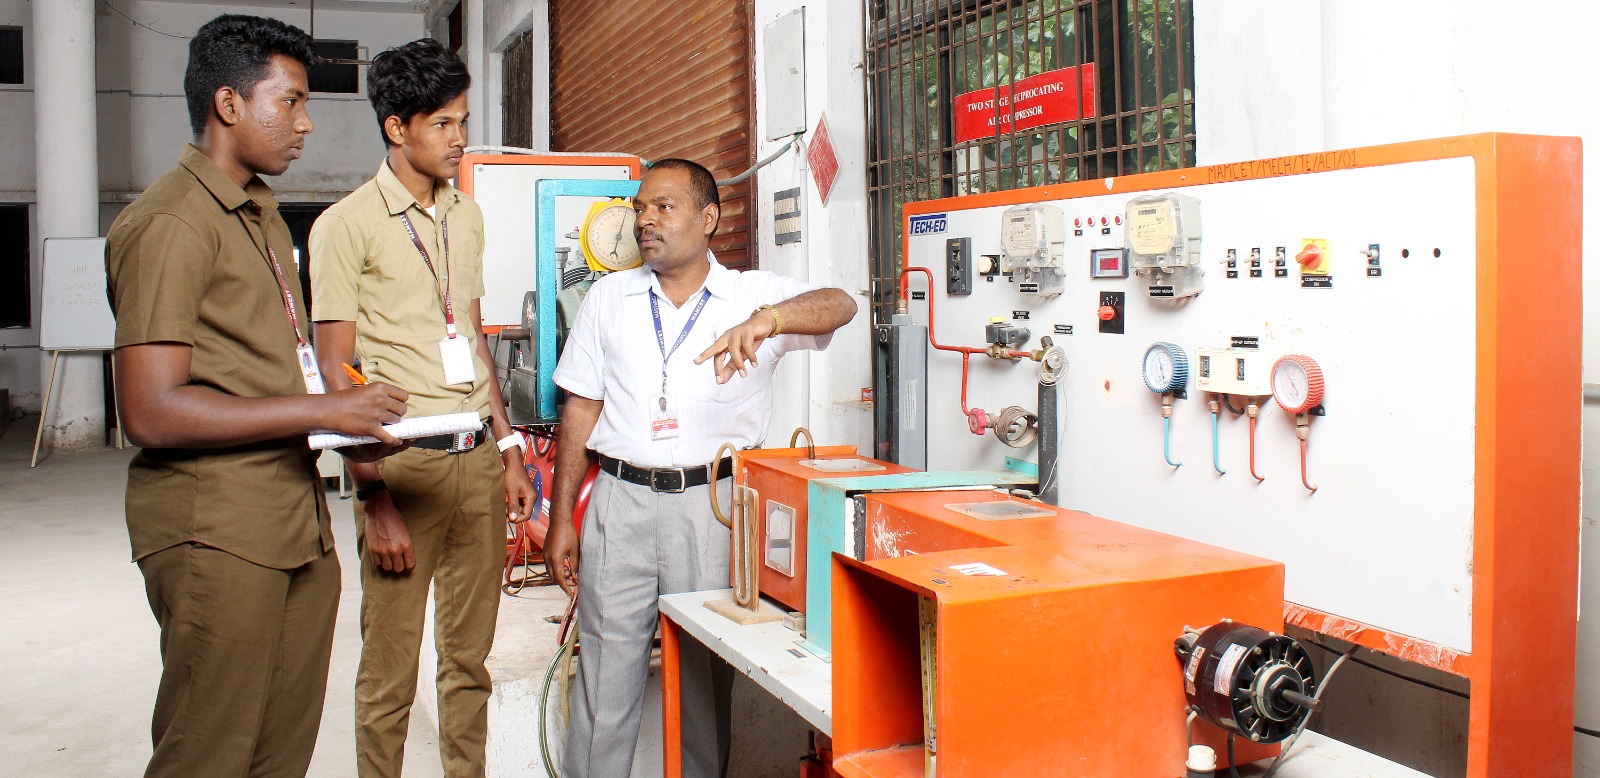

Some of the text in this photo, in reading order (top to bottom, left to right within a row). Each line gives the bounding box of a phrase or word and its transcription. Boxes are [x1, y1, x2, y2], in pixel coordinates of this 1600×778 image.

[967, 81, 1064, 113] TWO STGE ECIPROCATING
[910, 214, 947, 234] TECH-ED
[690, 298, 706, 322] MAMCET
